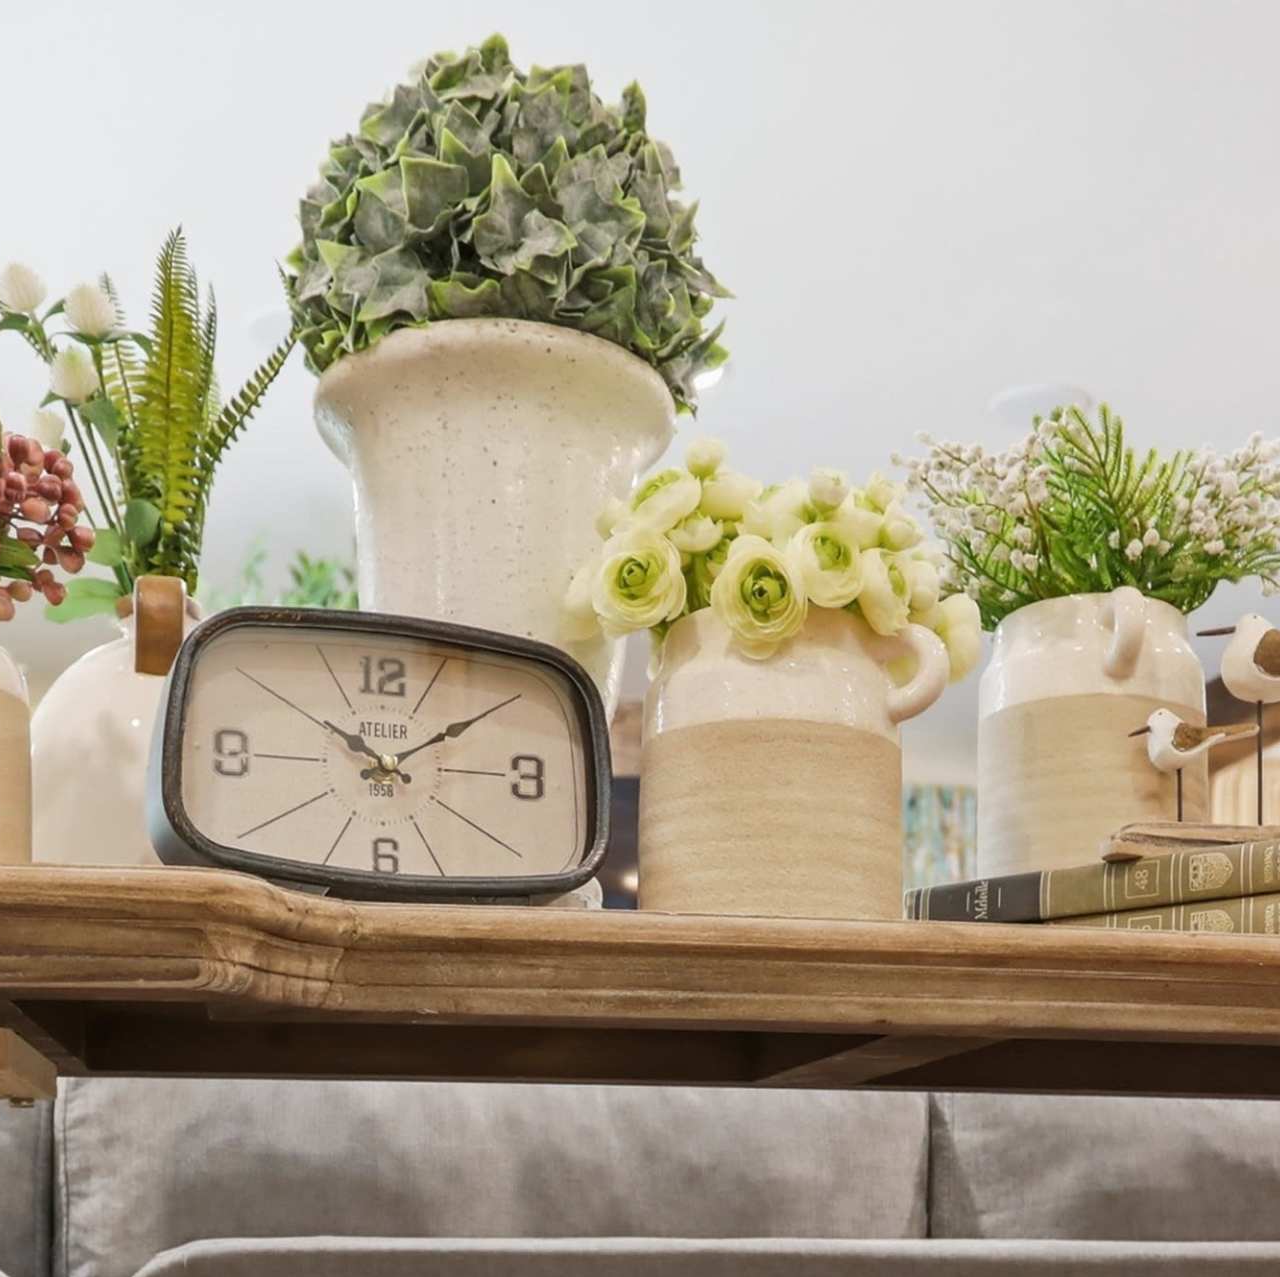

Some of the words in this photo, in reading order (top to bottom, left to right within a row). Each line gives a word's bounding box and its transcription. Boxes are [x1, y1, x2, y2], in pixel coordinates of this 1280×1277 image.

[358, 655, 407, 697] 12
[358, 720, 408, 739] ATELIER
[213, 728, 249, 777] 9
[510, 754, 545, 800] 3
[372, 837, 399, 873] 6
